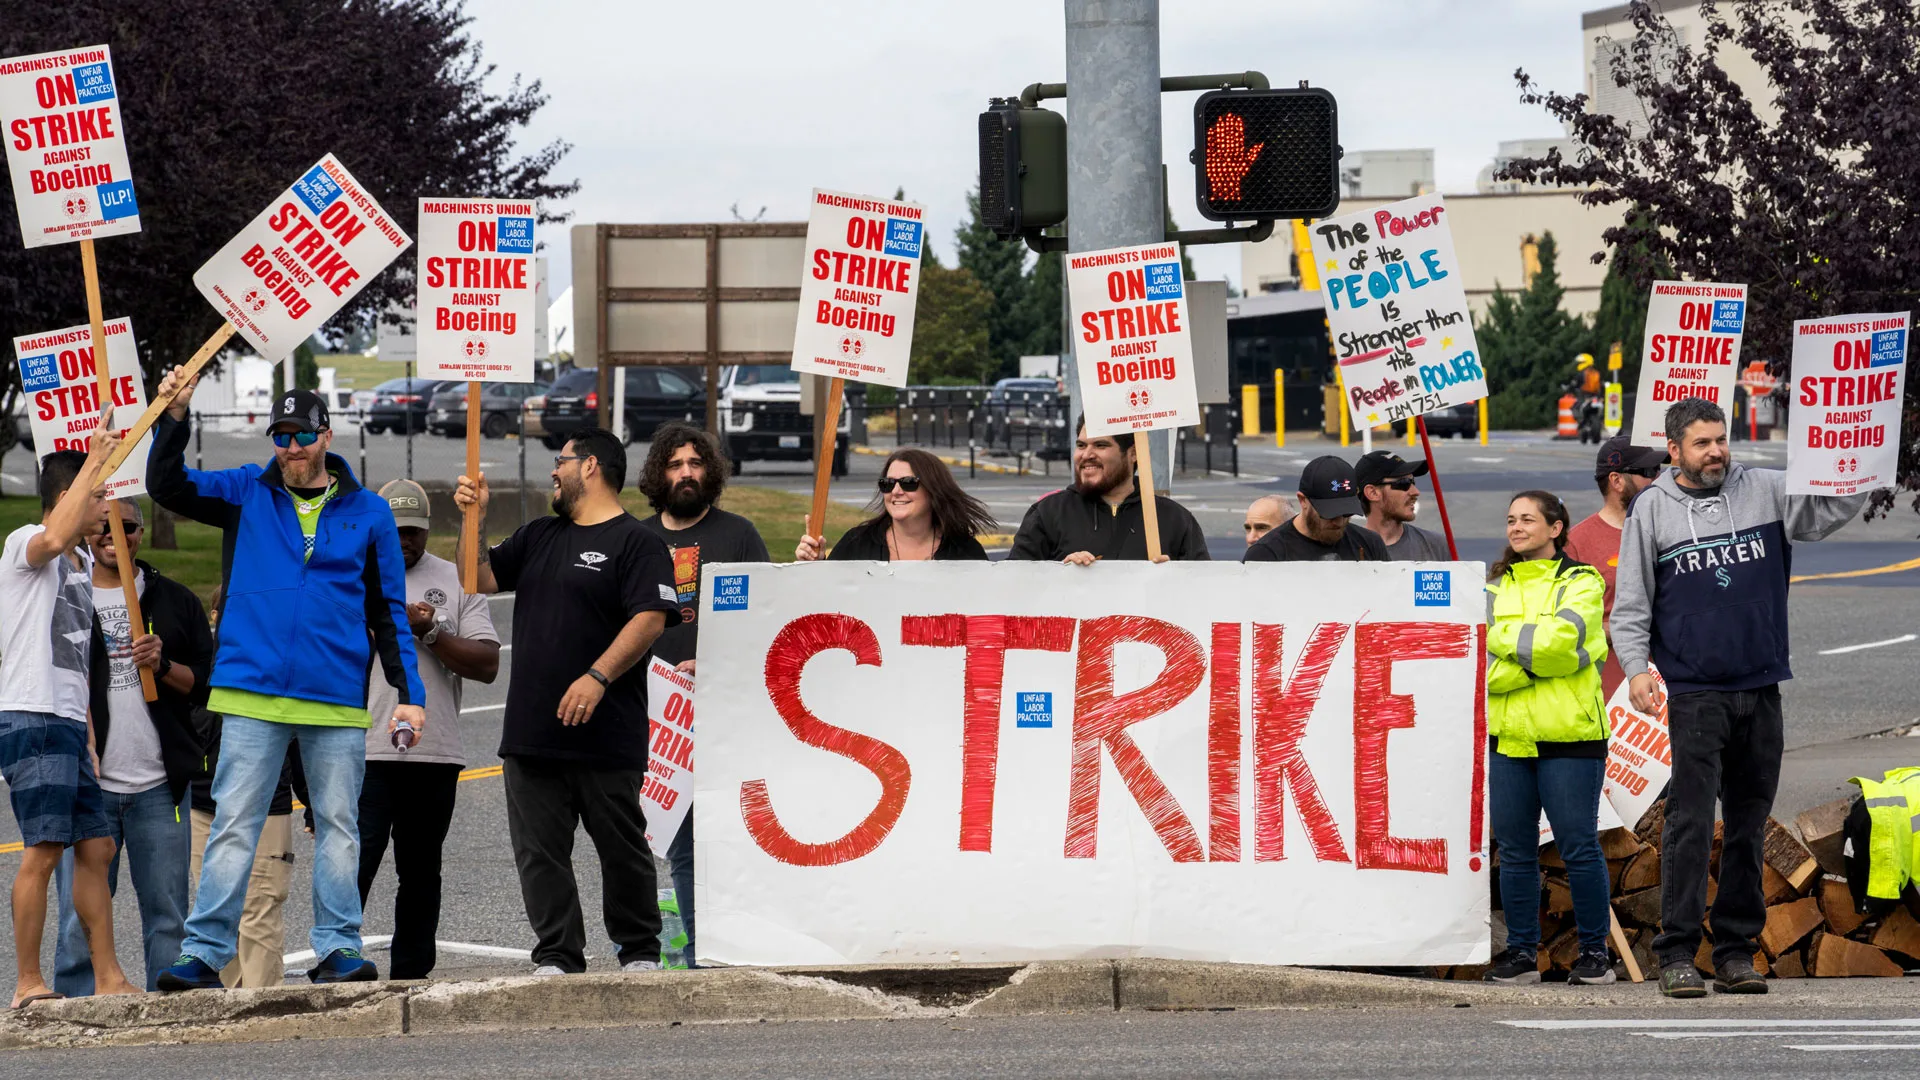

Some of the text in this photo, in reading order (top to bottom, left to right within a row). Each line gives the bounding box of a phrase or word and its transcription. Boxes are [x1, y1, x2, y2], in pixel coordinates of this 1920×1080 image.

[69, 50, 105, 65] UNION
[80, 66, 103, 77] UNFAIR
[83, 76, 104, 86] LABOR
[35, 73, 77, 109] ON
[78, 84, 113, 98] PRACTICES!
[10, 106, 114, 151] STRIKE
[43, 147, 91, 165] AGAINST
[30, 164, 113, 194] Boeing
[316, 172, 338, 194] UNFAIR
[102, 188, 132, 207] ULP!
[297, 180, 326, 210] PRACTICES!
[310, 179, 330, 199] LABOR
[322, 160, 405, 248] MACHINISTS UNION
[424, 203, 531, 215] MACHINISTS UNION
[817, 193, 922, 219] MACHINISTS UNION
[66, 222, 90, 230] DISTRICT
[320, 200, 366, 247] ON
[505, 220, 527, 228] UNFAIR
[894, 222, 915, 232] UNFAIR
[1316, 206, 1444, 252] The Power
[458, 220, 496, 252] ON
[506, 229, 526, 238] LABOR
[846, 216, 886, 252] ON
[894, 231, 913, 241] LABOR
[268, 202, 360, 297] STRIKE
[498, 238, 532, 248] PRACTICES!
[886, 240, 920, 252] PRACTICES!
[272, 246, 315, 288] AGAINST
[1072, 247, 1175, 269] MACHINISTS UNION
[1349, 246, 1404, 271] of the
[426, 256, 527, 289] STRIKE
[812, 248, 911, 294] STRIKE
[1151, 266, 1173, 276] UNFAIR
[1153, 275, 1173, 284] LABOR
[1326, 249, 1448, 310] PEOPLE
[240, 243, 312, 320] Boeing
[1107, 268, 1146, 302] ON
[1147, 284, 1180, 294] PRACTICES!
[452, 293, 500, 306] AGAINST
[834, 288, 882, 306] AGAINST
[1656, 285, 1743, 298] MACHINISTS UNION
[230, 302, 251, 327] DISTRICT
[248, 322, 264, 338] LODGE
[436, 307, 516, 335] Boeing
[816, 300, 895, 338] Boeing
[1081, 302, 1181, 343] STRIKE
[1425, 308, 1464, 332] than
[1679, 302, 1712, 331] ON
[1713, 320, 1741, 328] PRACTICES!
[1720, 311, 1736, 319] LABOR
[1800, 318, 1905, 335] MACHINISTS UNION
[20, 330, 90, 352] MACHINISTS
[1878, 332, 1898, 342] UNFAIR
[1879, 341, 1897, 350] LABOR
[1111, 340, 1157, 358] AGAINST
[1650, 334, 1734, 365] STRIKE
[1834, 339, 1871, 371] ON
[1872, 350, 1902, 361] PRACTICES!
[26, 357, 50, 368] UNFAIR
[59, 346, 96, 381] ON
[837, 360, 859, 369] DISTRICT
[860, 363, 876, 372] LODGE
[1387, 351, 1416, 372] the
[30, 366, 50, 377] LABOR
[1097, 357, 1176, 385] Boeing
[1404, 374, 1419, 391] in
[1419, 350, 1483, 393] POWER
[1668, 368, 1708, 380] AGAINST
[24, 375, 59, 387] PRACTICES!
[1800, 371, 1898, 407] STRIKE
[1385, 393, 1449, 423] IAM 751
[1129, 413, 1151, 422] DISTRICT
[1825, 410, 1872, 425] AGAINST
[1808, 425, 1885, 449] Boeing
[1833, 479, 1856, 487] DISTRICT
[1857, 477, 1870, 485] LODGE
[389, 497, 418, 506] PFG
[721, 578, 742, 586] UNFAIR
[1422, 573, 1443, 581] UNFAIR
[1422, 582, 1442, 590] LABOR
[722, 586, 741, 595] LABOR
[1416, 592, 1450, 600] PRACTICES!
[714, 596, 747, 605] PRACTICES!
[1024, 694, 1045, 702] UNFAIR
[663, 692, 694, 731] ON
[1018, 713, 1052, 721] PRACTICES!
[1025, 704, 1044, 712] LABOR
[740, 611, 1485, 874] STRIKE!
[1609, 742, 1648, 768] AGAINST
